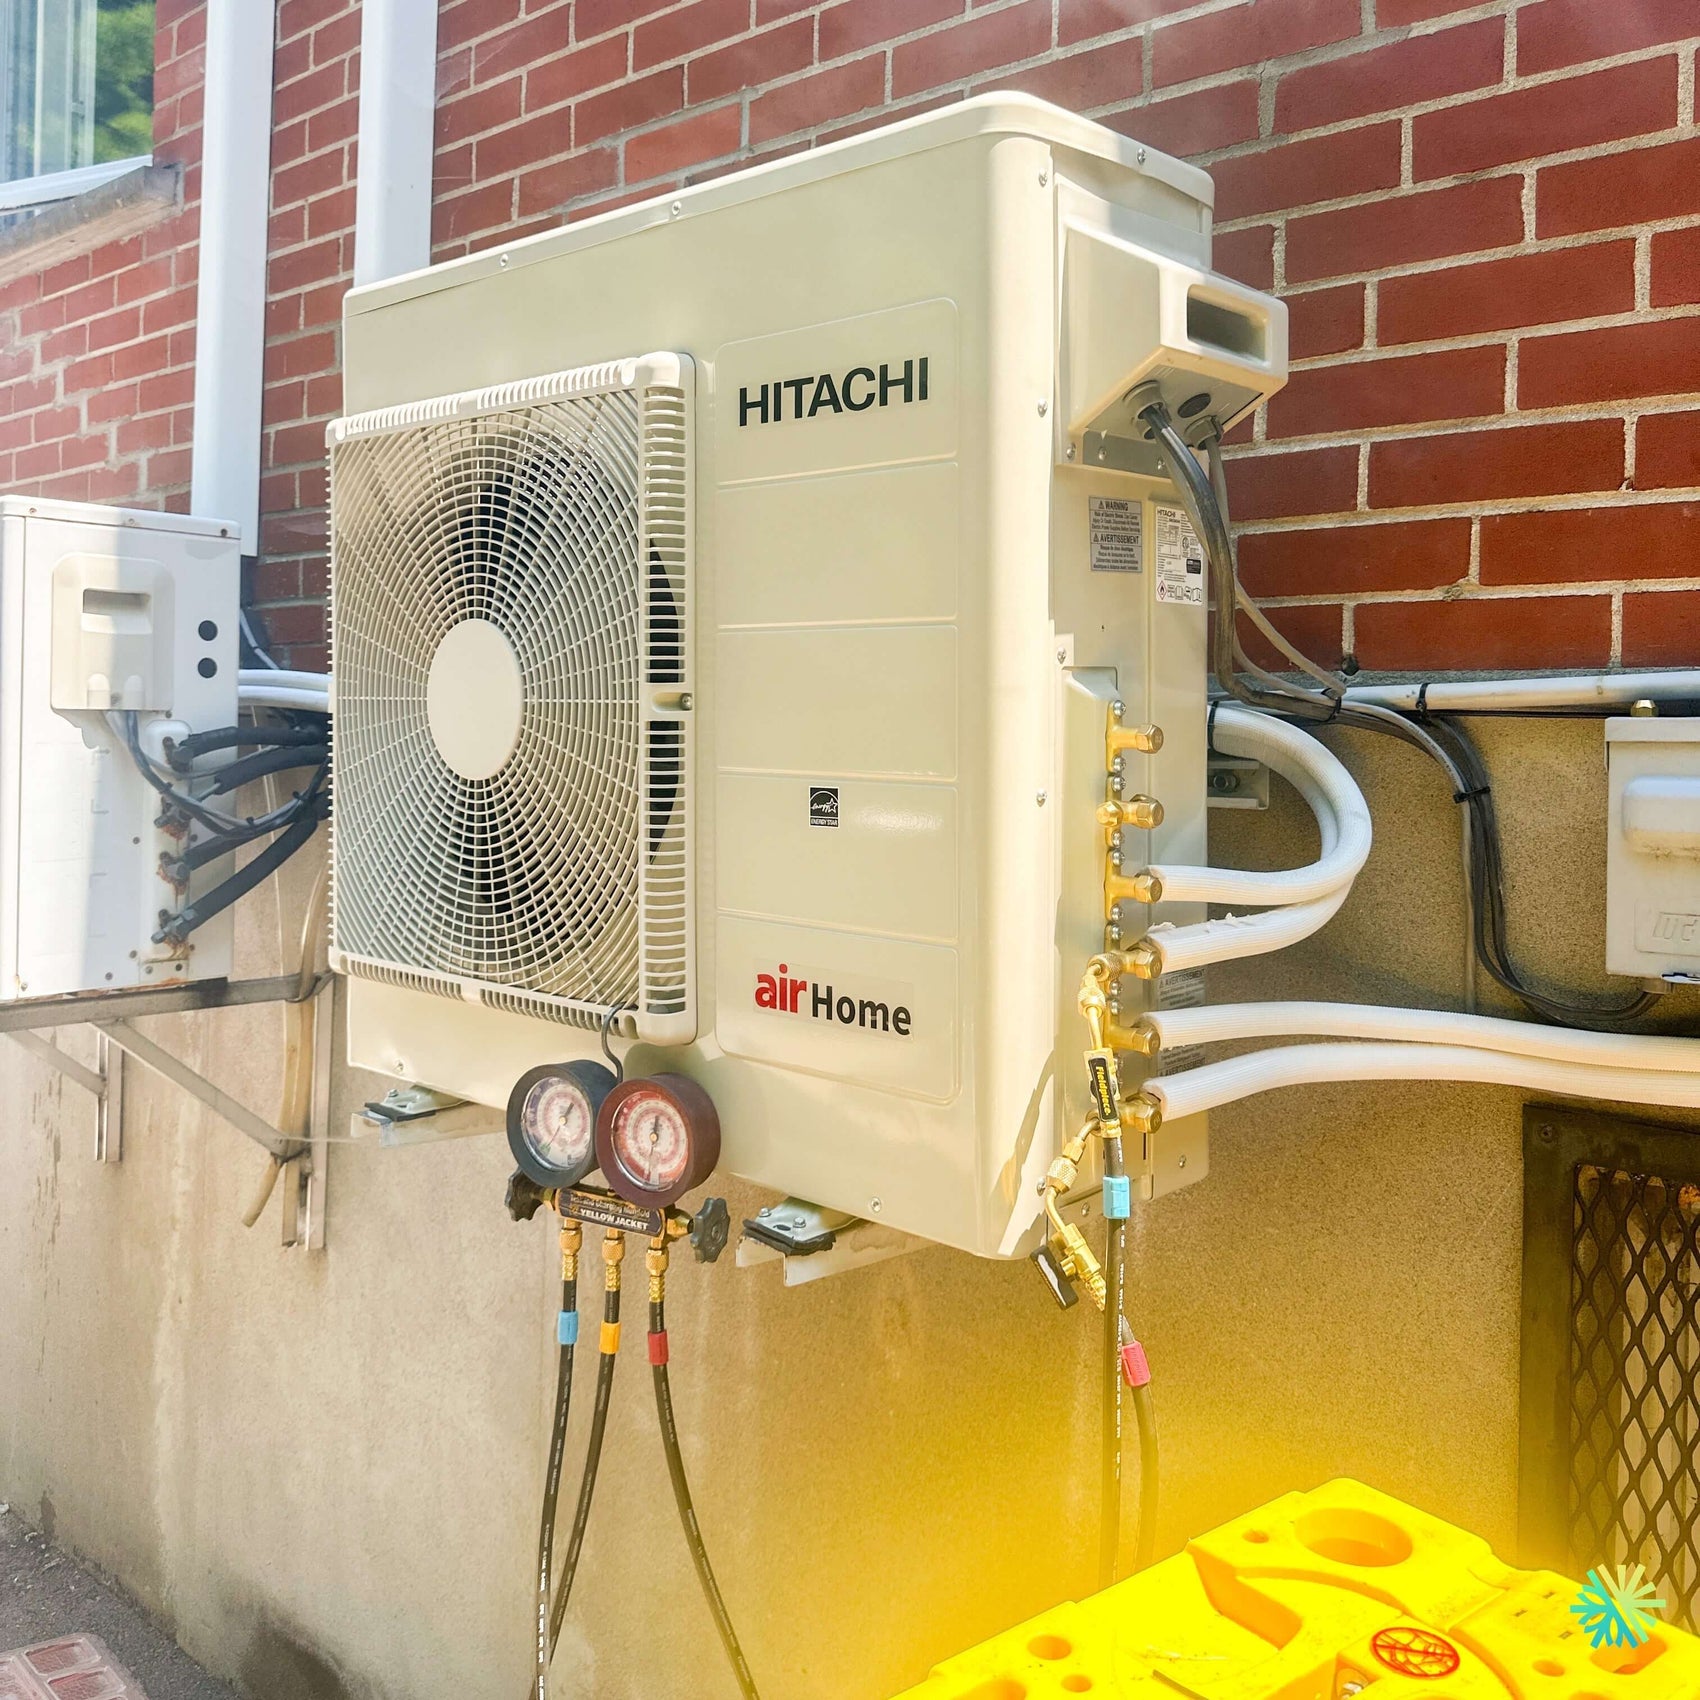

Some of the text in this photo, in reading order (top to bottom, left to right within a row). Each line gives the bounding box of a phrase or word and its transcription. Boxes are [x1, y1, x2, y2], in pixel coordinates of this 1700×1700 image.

[739, 357, 928, 426] HITACHI
[1105, 501, 1129, 511] WARNING
[1100, 534, 1139, 544] AVERTISSEMENT
[755, 963, 911, 1035] air Home
[580, 1208, 649, 1231] YELLOW JACKET
